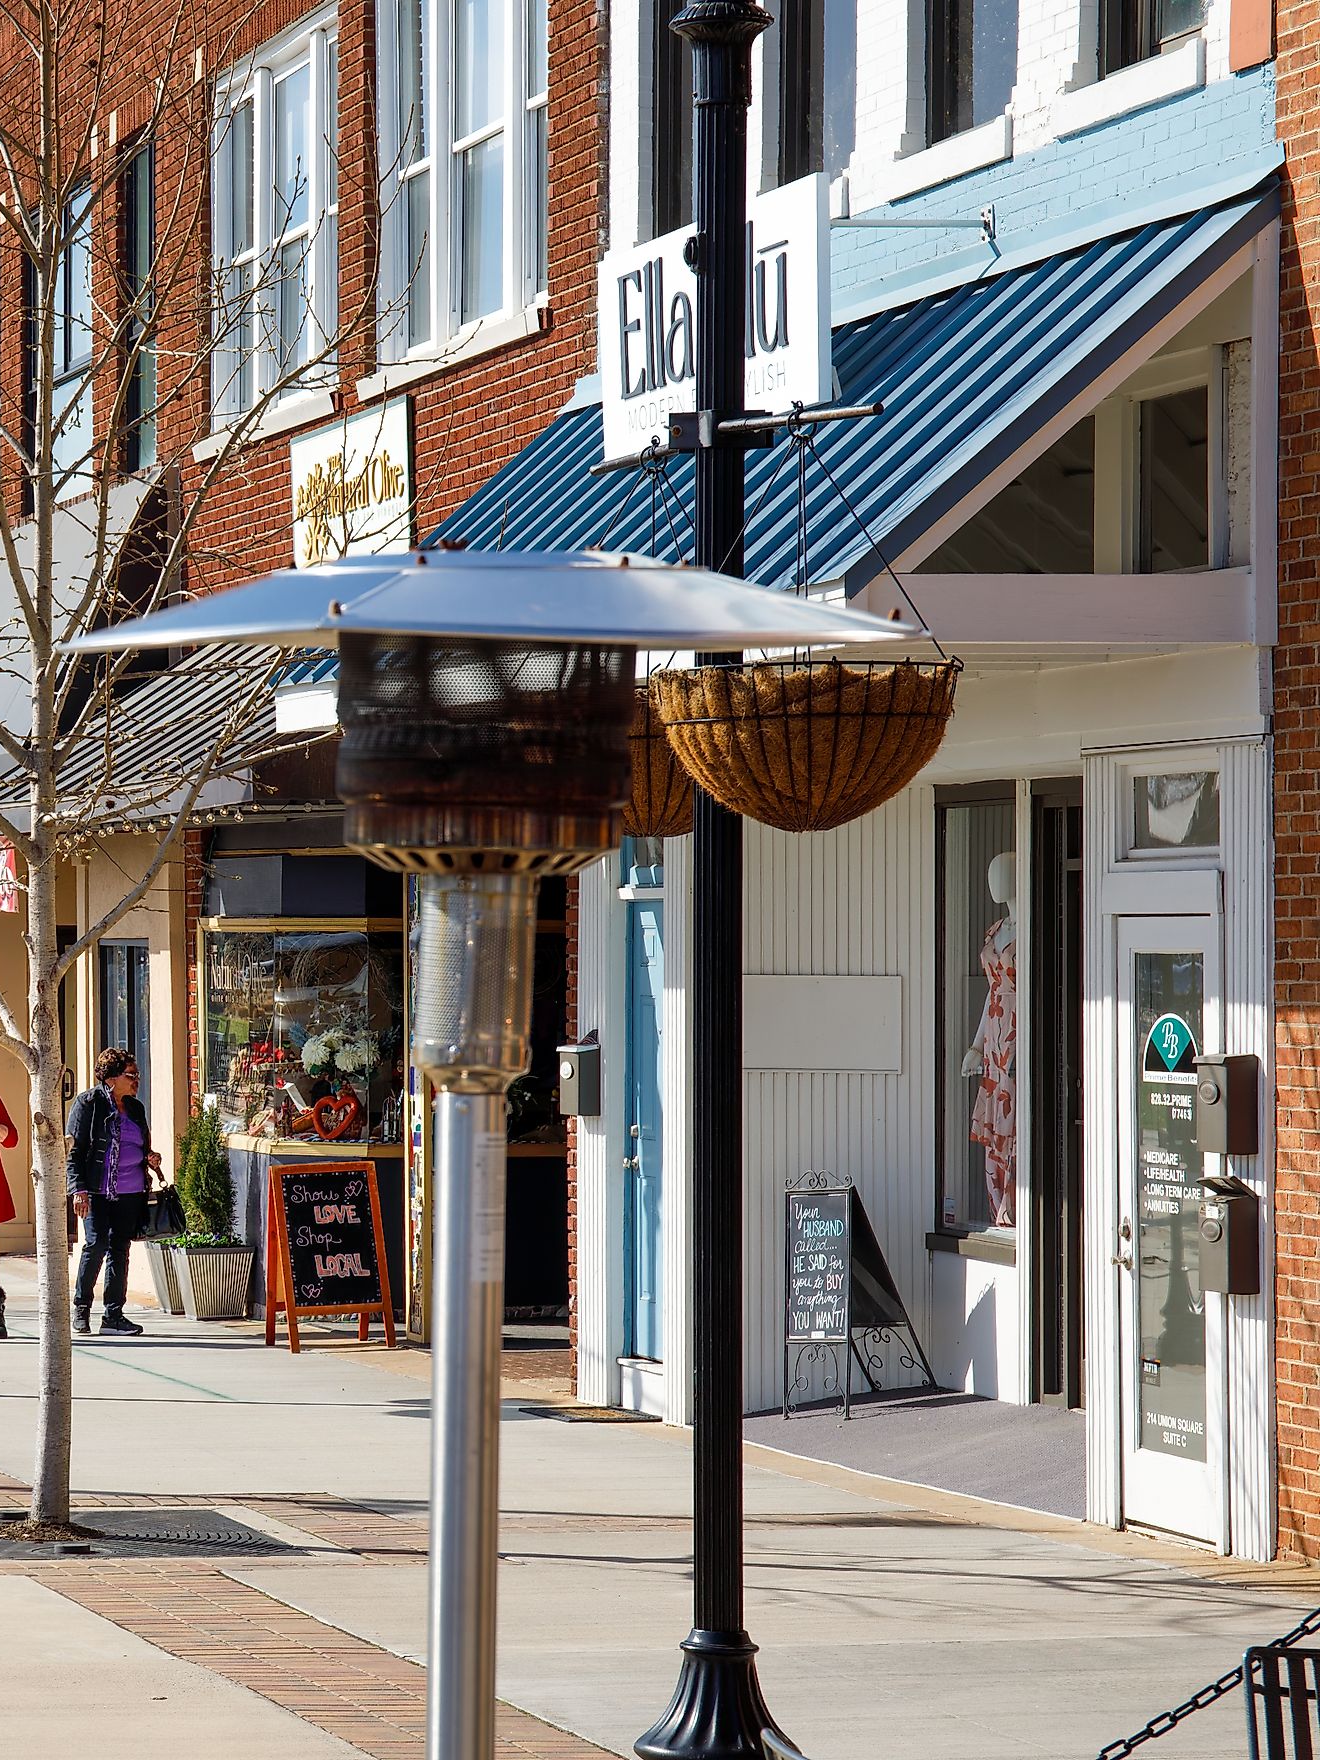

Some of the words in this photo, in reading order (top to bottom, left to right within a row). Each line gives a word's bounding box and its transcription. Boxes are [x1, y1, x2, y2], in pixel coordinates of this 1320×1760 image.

[617, 257, 695, 400] Ella
[745, 360, 786, 398] YLISH
[371, 450, 405, 505] Olive
[210, 954, 240, 990] Natural
[1145, 1073, 1167, 1081] Prime
[1147, 1151, 1178, 1166] MEDICARE
[291, 1184, 339, 1203] Show
[1147, 1183, 1164, 1196] LONG
[1165, 1185, 1182, 1198] TERM
[1183, 1187, 1201, 1200] CARE
[313, 1204, 361, 1224] LOVE
[795, 1203, 820, 1230] Your
[1147, 1200, 1179, 1214] ANNUITIES
[296, 1226, 342, 1251] Shop
[803, 1219, 844, 1238] HUSBAND
[314, 1253, 370, 1278] LOCAL
[793, 1256, 805, 1274] HE
[808, 1254, 827, 1271] SAID
[829, 1254, 844, 1274] for
[793, 1279, 813, 1295] you
[813, 1275, 824, 1289] to
[826, 1274, 844, 1291] BUY
[798, 1291, 842, 1312] anything
[793, 1311, 809, 1330] YOU
[816, 1308, 844, 1333] WANT!
[1146, 1411, 1157, 1425] 214
[1158, 1413, 1177, 1429] UNION
[1177, 1418, 1203, 1435] SQUARE
[1163, 1431, 1181, 1447] SUITE
[1181, 1436, 1187, 1447] C
